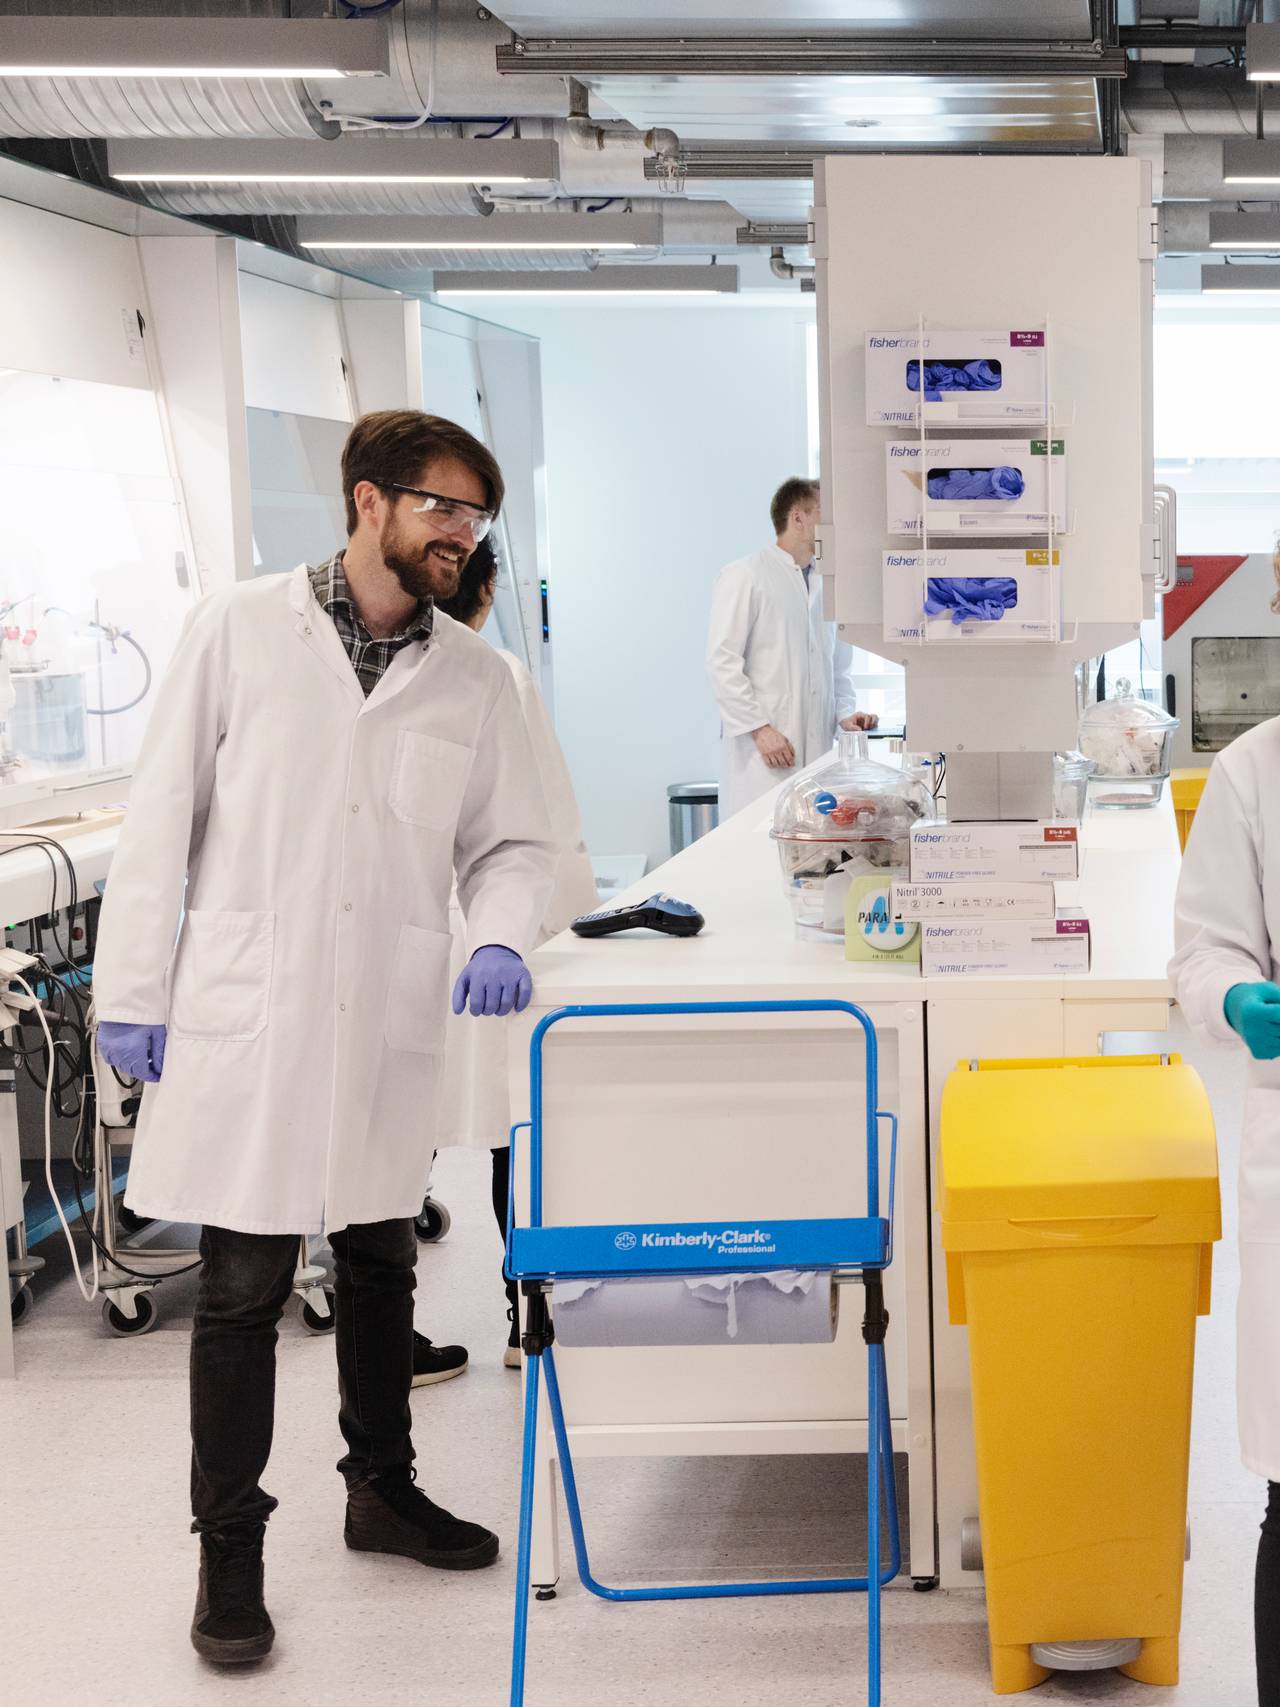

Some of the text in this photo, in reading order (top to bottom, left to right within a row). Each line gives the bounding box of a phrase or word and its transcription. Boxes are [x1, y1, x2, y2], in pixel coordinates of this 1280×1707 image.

[883, 411, 914, 421] NITRILE
[890, 446, 951, 457] fisherrand
[886, 555, 947, 566] fisherband
[914, 833, 970, 843] fisherbrand
[926, 871, 955, 880] NITRILE
[920, 887, 942, 897] 3000
[858, 912, 889, 923] PARA
[926, 927, 983, 937] fisherbrand
[938, 964, 967, 973] NITRILE
[717, 1244, 776, 1254] Professional
